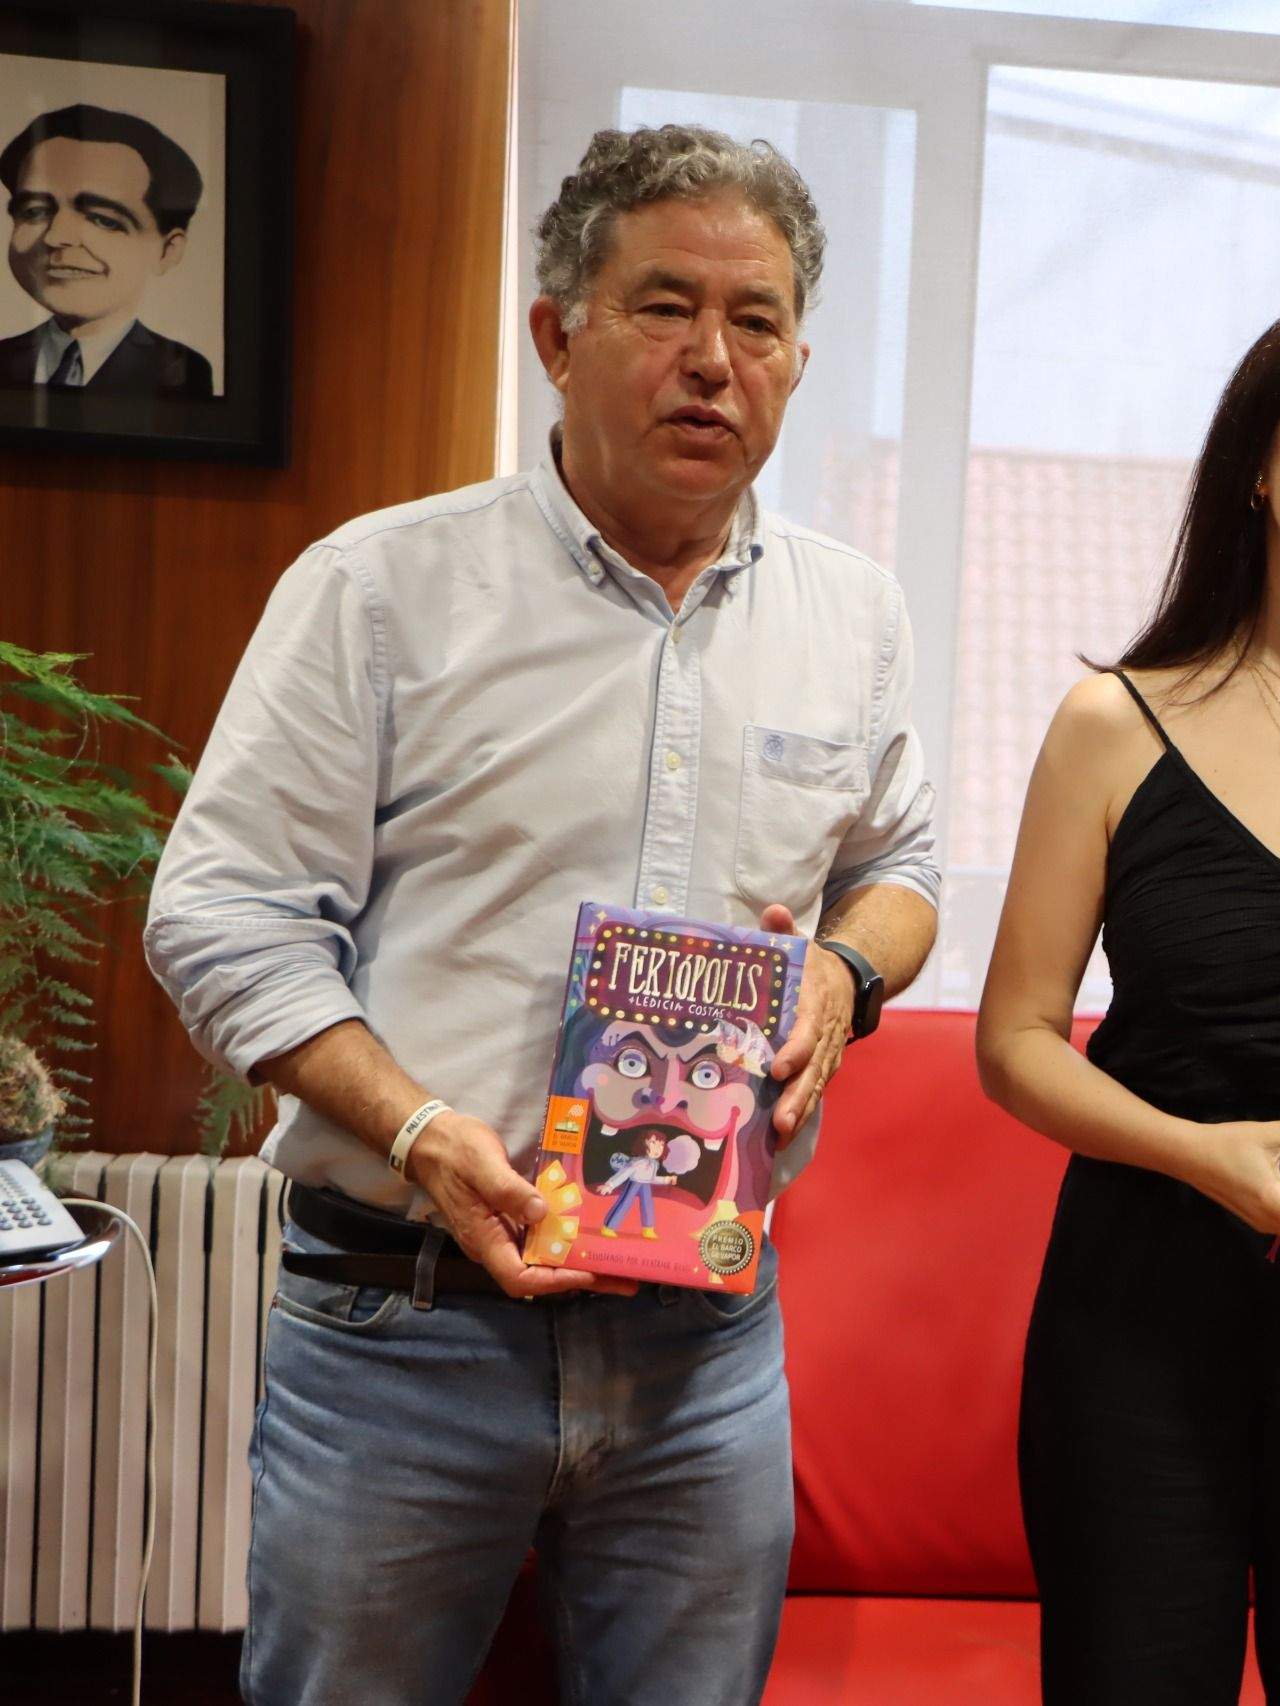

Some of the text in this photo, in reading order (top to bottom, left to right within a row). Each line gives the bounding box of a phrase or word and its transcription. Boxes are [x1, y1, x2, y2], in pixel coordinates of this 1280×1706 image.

[608, 942, 763, 1012] FERIÓPOLIS
[635, 996, 725, 1019] LEDICIA COSTAS
[713, 1234, 743, 1245] PREMIO
[720, 1243, 742, 1253] BARCO
